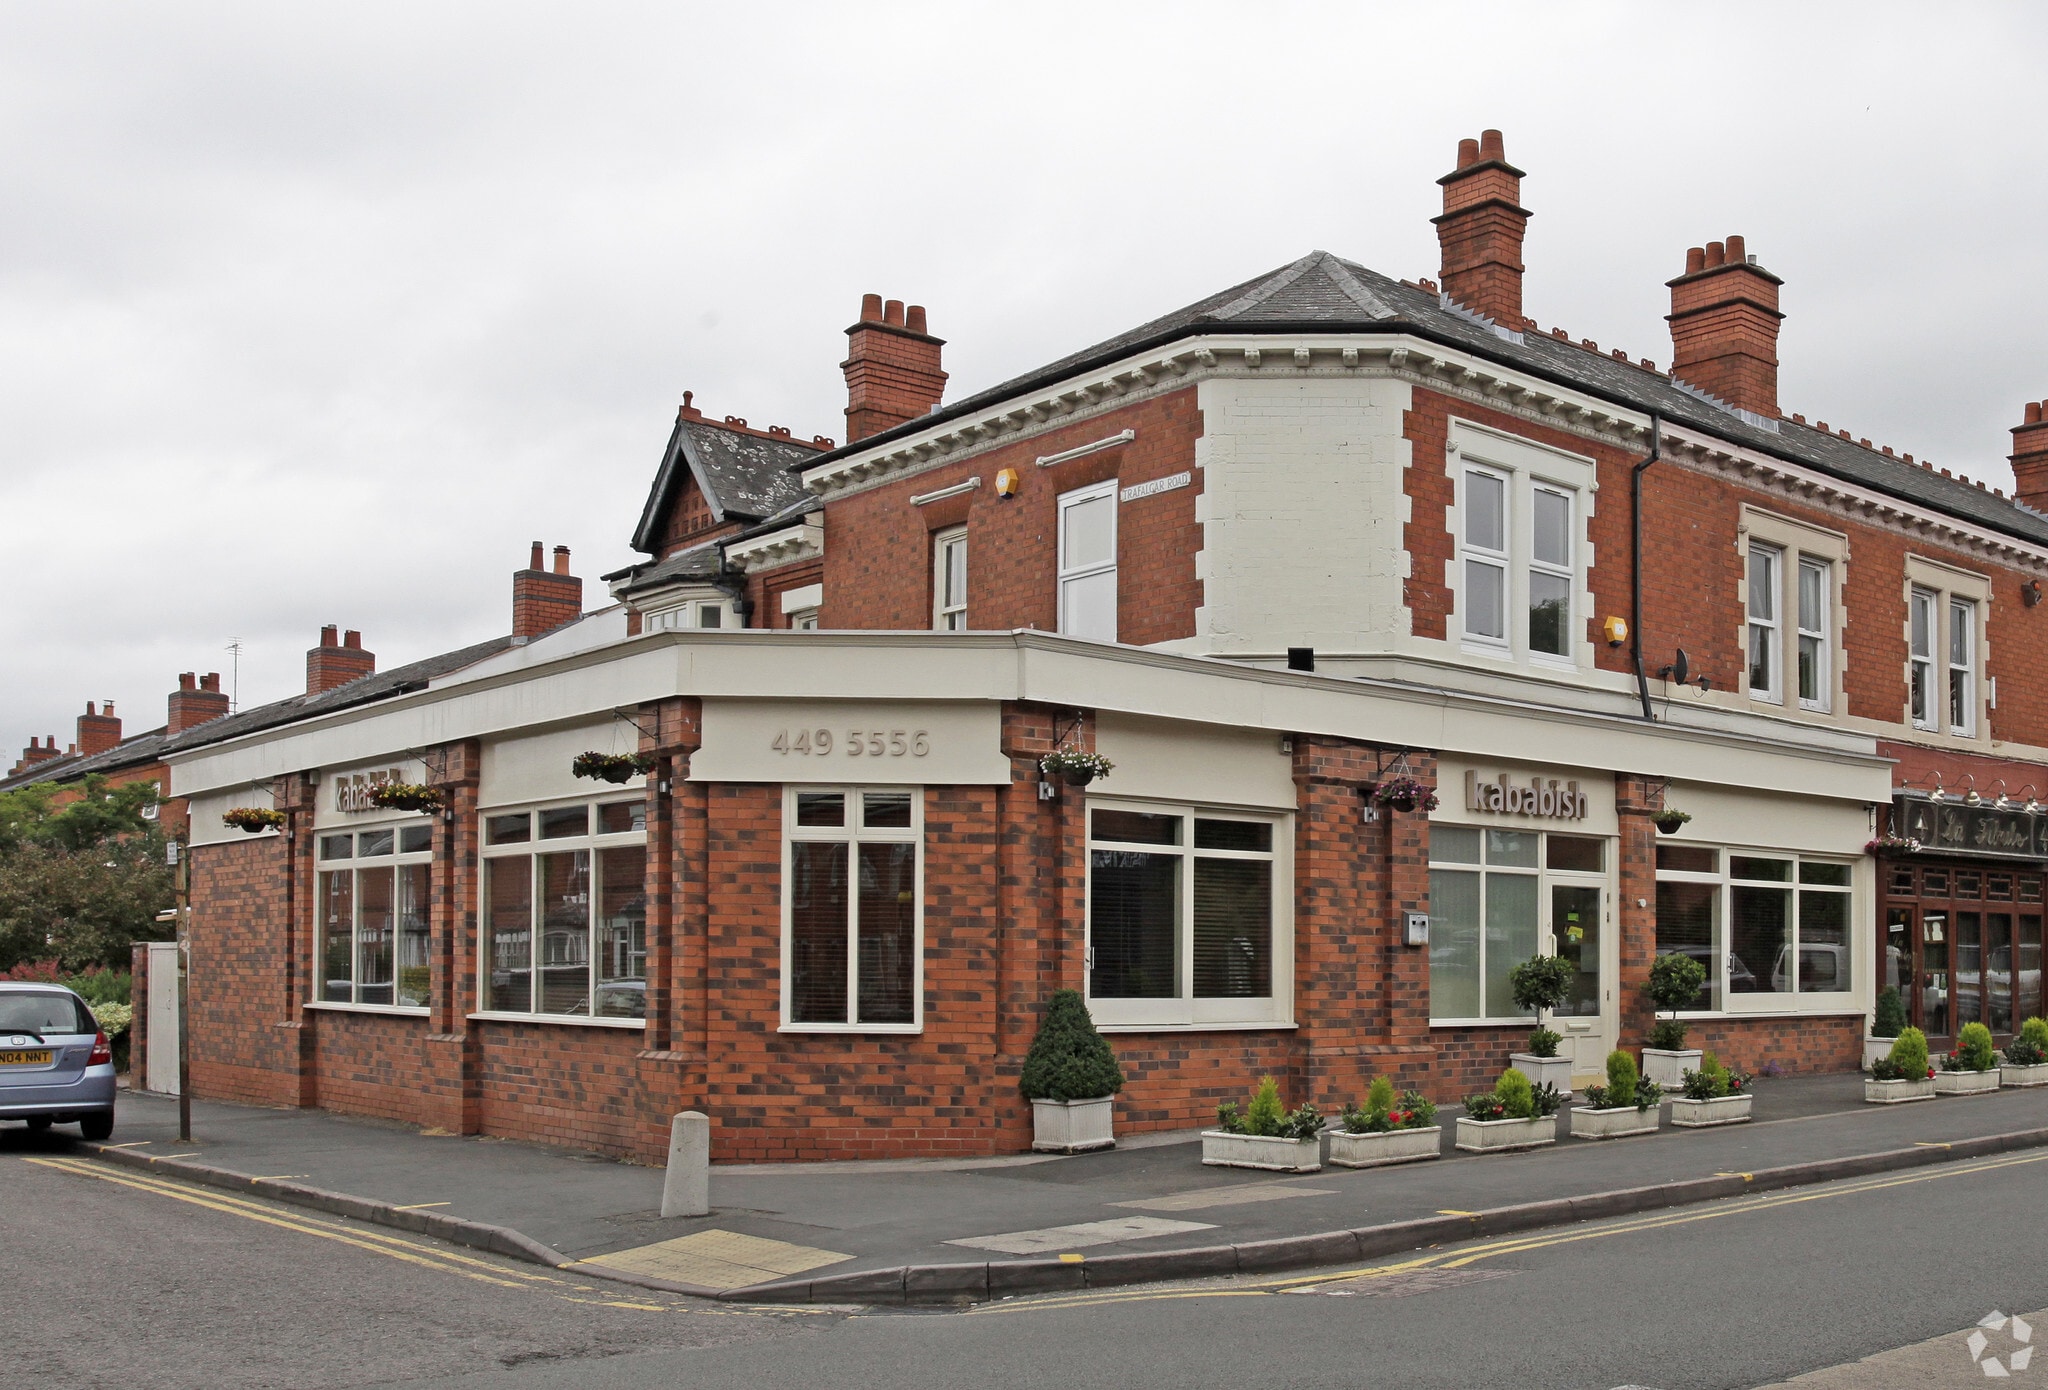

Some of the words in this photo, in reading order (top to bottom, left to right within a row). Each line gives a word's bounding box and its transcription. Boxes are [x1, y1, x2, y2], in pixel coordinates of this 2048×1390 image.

[1123, 480, 1165, 500] TRAFALGAR
[1167, 473, 1189, 490] ROAD
[771, 728, 833, 756] 449
[847, 729, 930, 758] 5556
[1465, 769, 1589, 819] kababish
[25, 1051, 49, 1063] NNT
